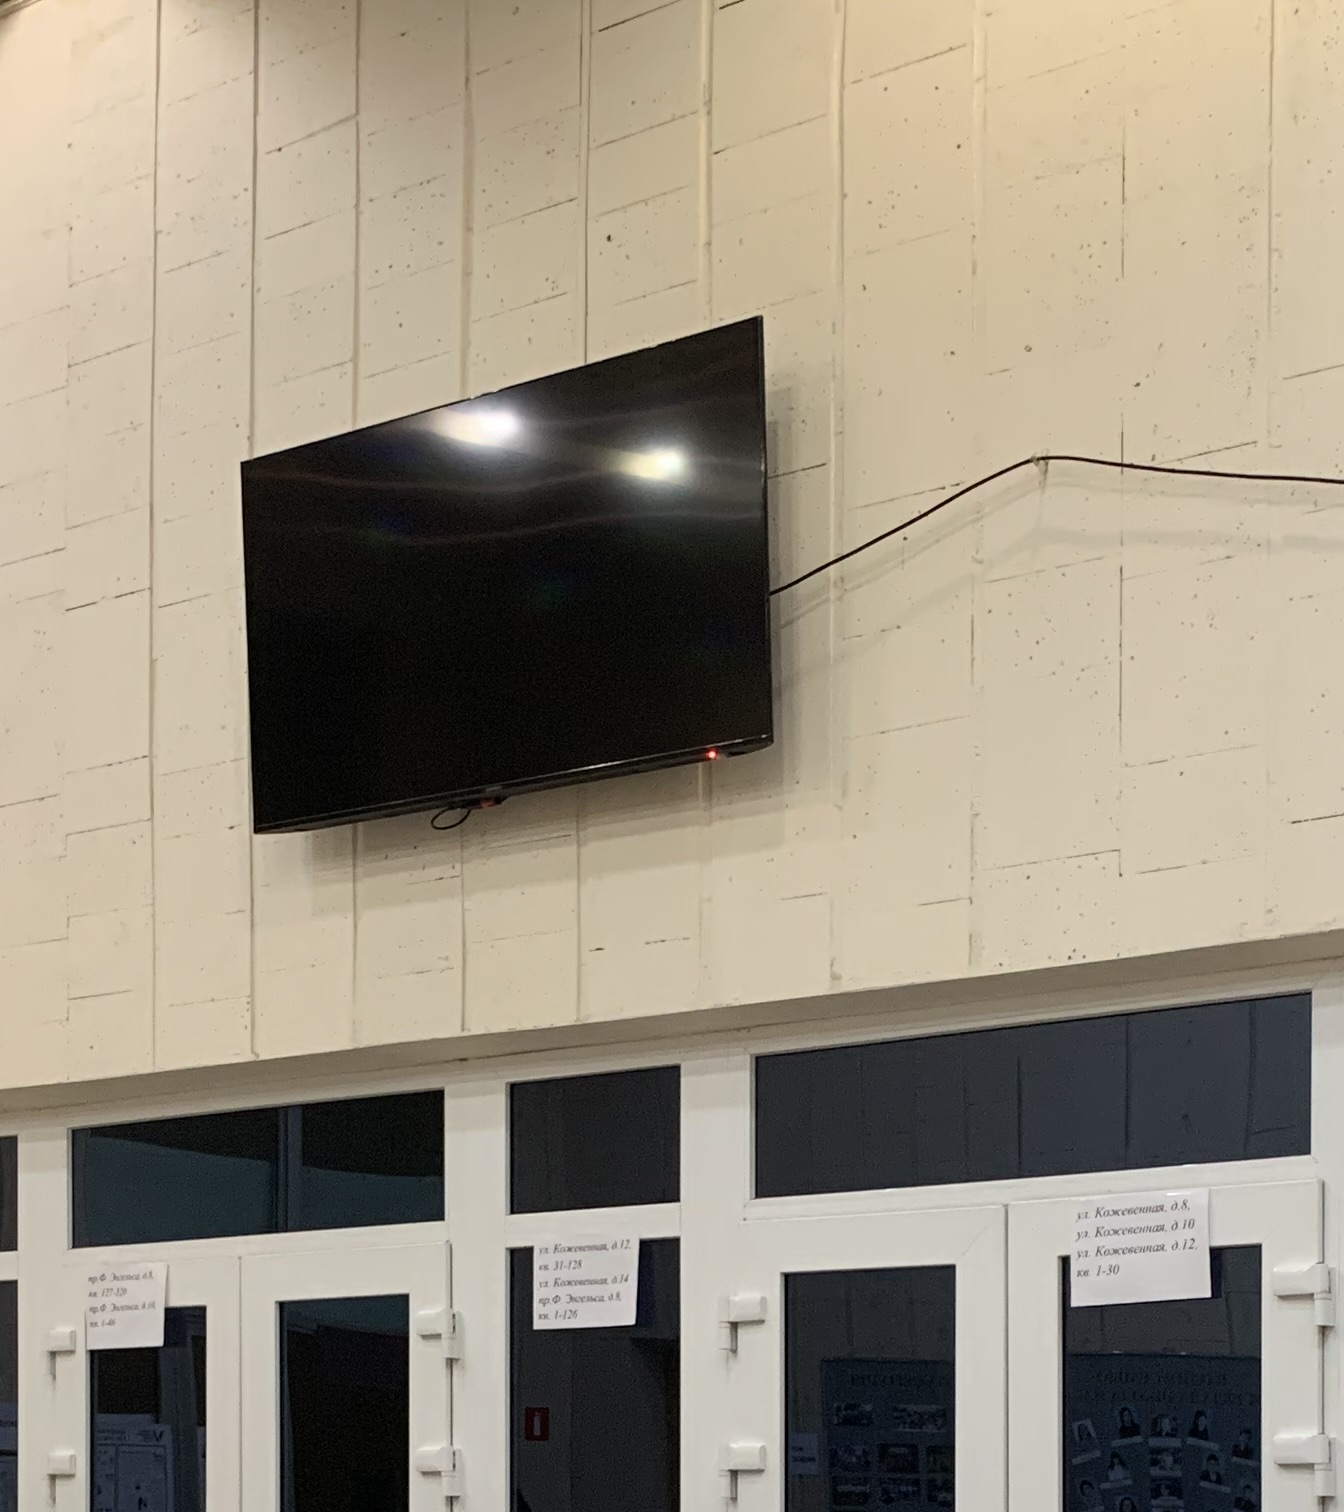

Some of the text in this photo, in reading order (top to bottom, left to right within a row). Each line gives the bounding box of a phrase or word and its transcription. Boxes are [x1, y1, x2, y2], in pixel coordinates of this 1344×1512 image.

[1076, 1199, 1190, 1223] ул. Кожевенная, д.8,
[1075, 1219, 1195, 1242] ул. Кожевенная, д.10
[1076, 1238, 1198, 1261] ул. Кожевенная, д.12,
[1077, 1264, 1120, 1278] кв. 1-30
